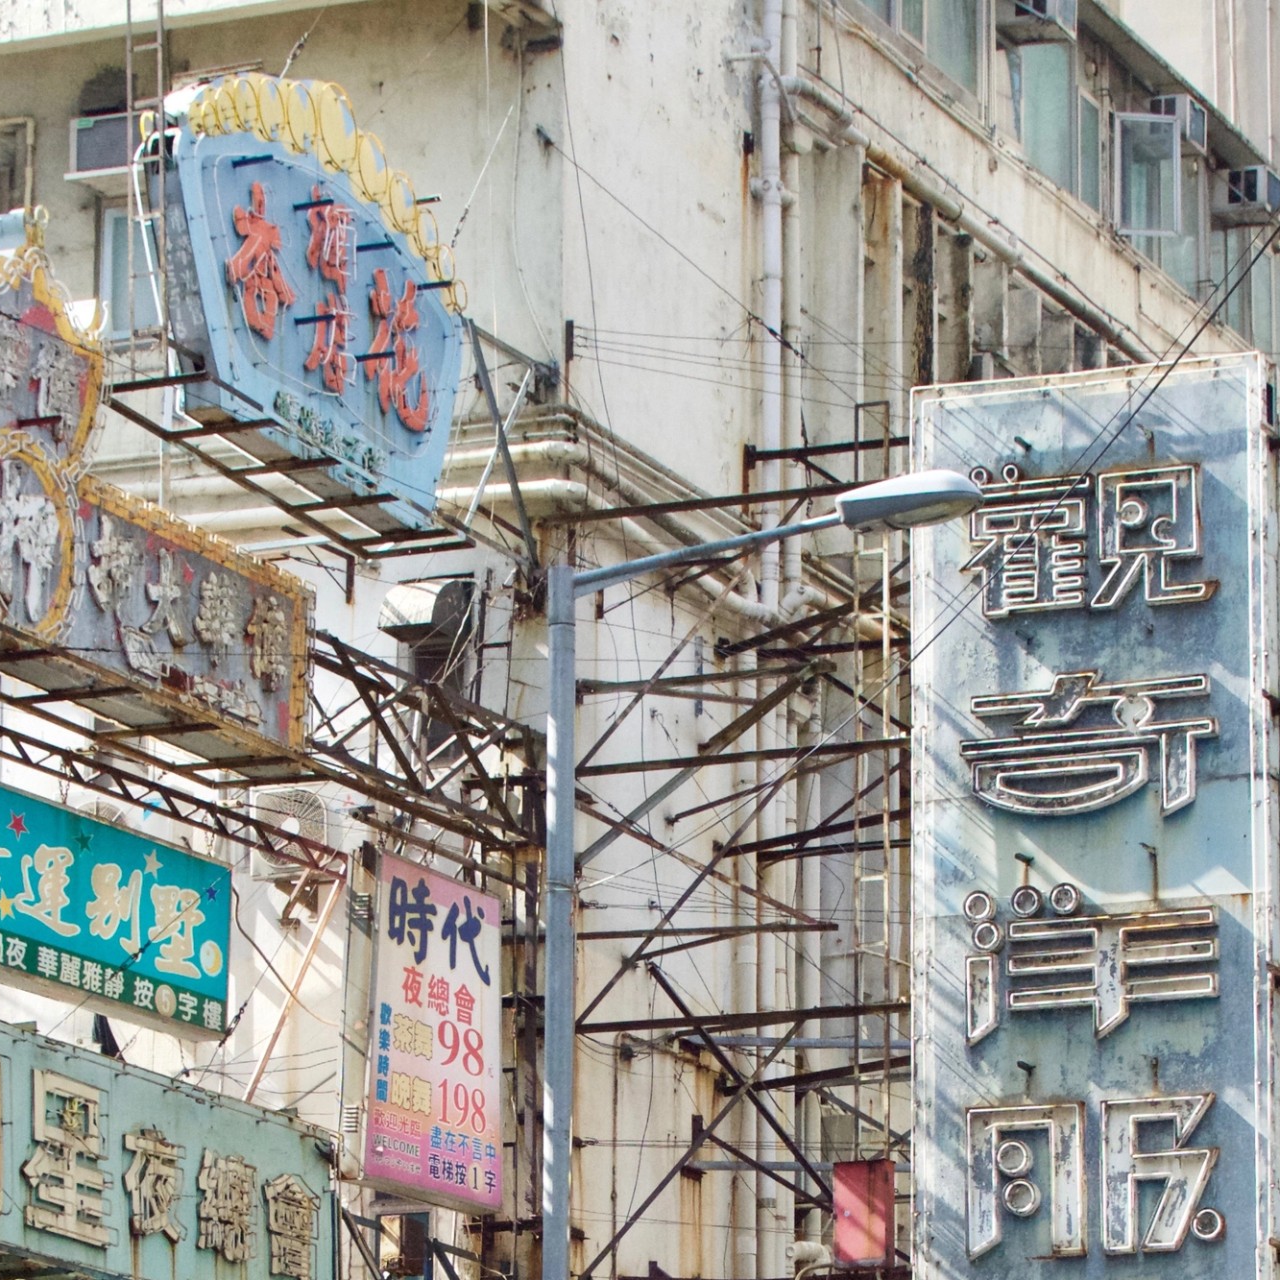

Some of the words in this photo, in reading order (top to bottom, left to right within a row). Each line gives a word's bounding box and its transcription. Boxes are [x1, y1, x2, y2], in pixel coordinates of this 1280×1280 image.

[961, 463, 1226, 1262] 觀奇洋服
[388, 876, 491, 987] 時代
[402, 966, 475, 1026] 夜總會
[393, 1013, 433, 1061] 茶舞
[438, 1020, 484, 1076] 98
[374, 1109, 421, 1137] 歡迎光臨
[438, 1079, 486, 1134] 198
[374, 1134, 420, 1156] WELCOME
[430, 1126, 496, 1164] 盡在不言中
[429, 1154, 496, 1193] 電梯按1字
